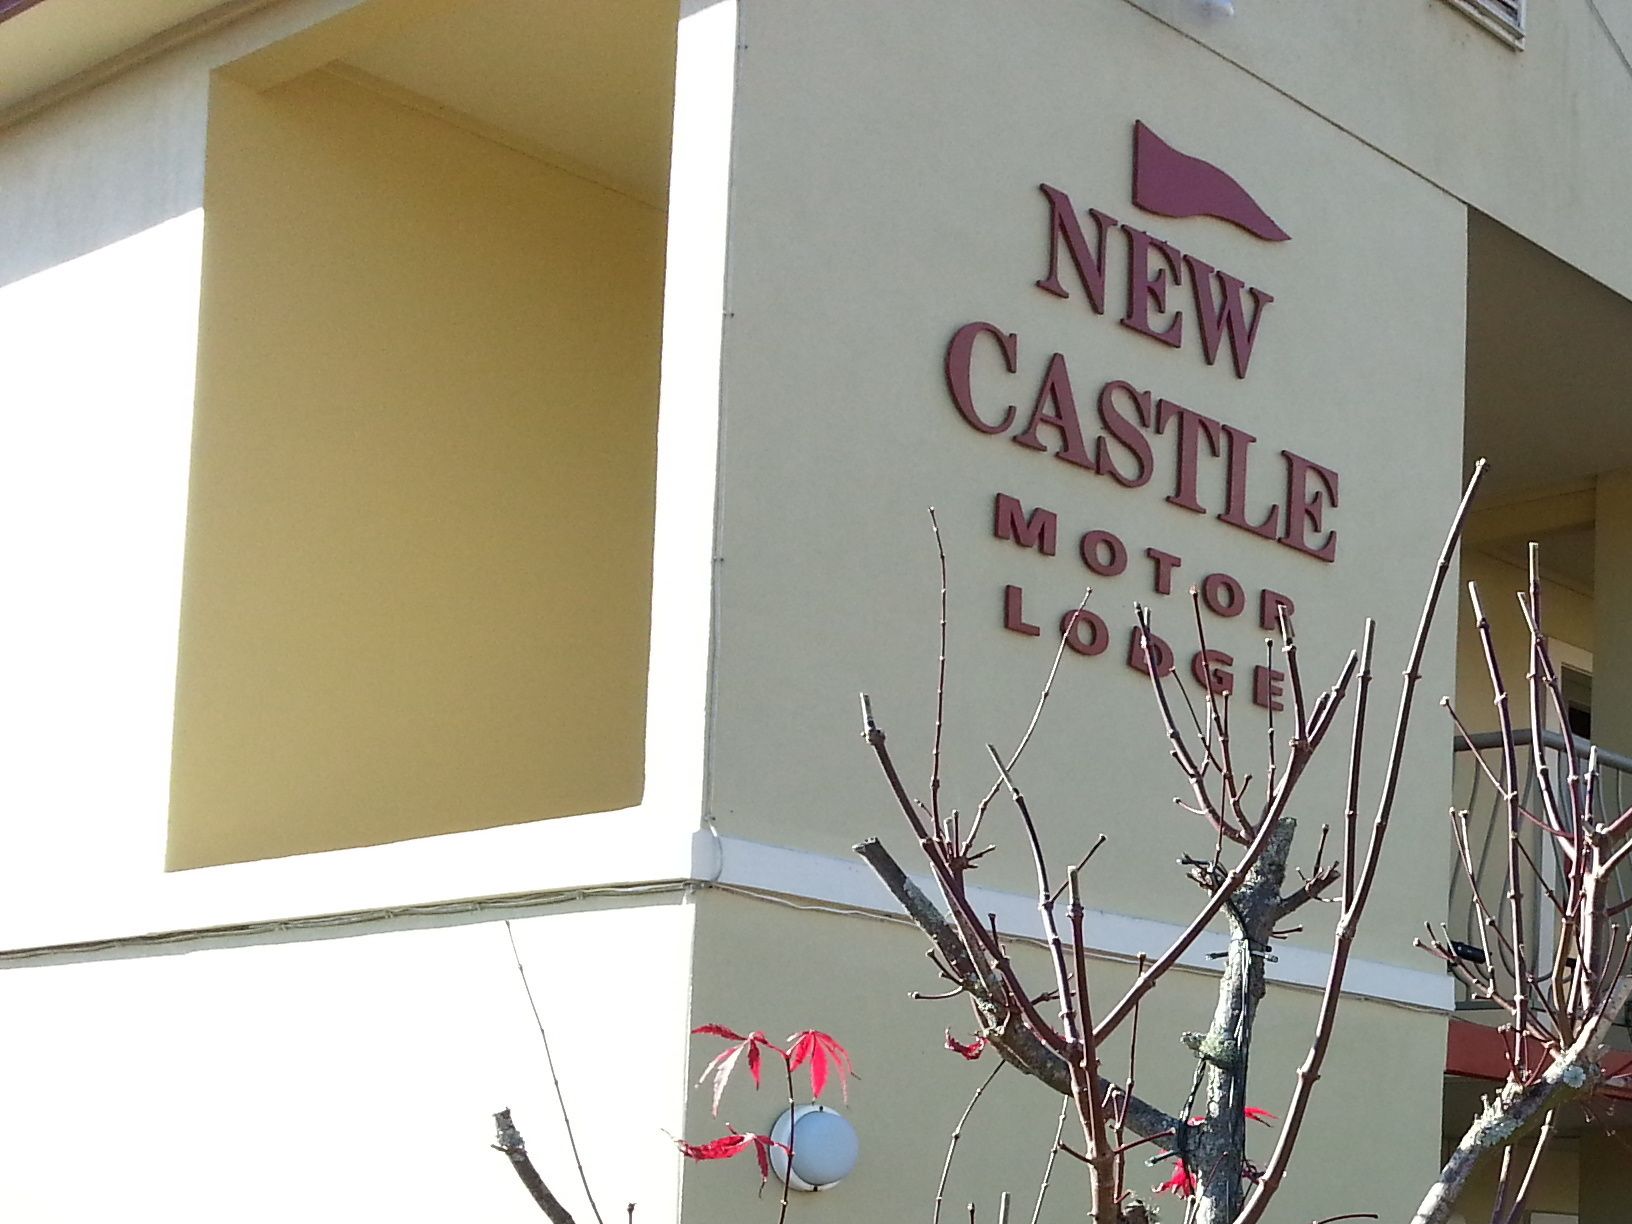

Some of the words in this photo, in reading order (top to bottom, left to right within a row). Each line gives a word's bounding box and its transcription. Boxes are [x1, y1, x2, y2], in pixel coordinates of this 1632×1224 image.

[1036, 182, 1275, 380] NEW
[944, 321, 1339, 563] CASTLE
[994, 492, 1295, 637] MOTOR
[1004, 585, 1285, 711] LODGE
